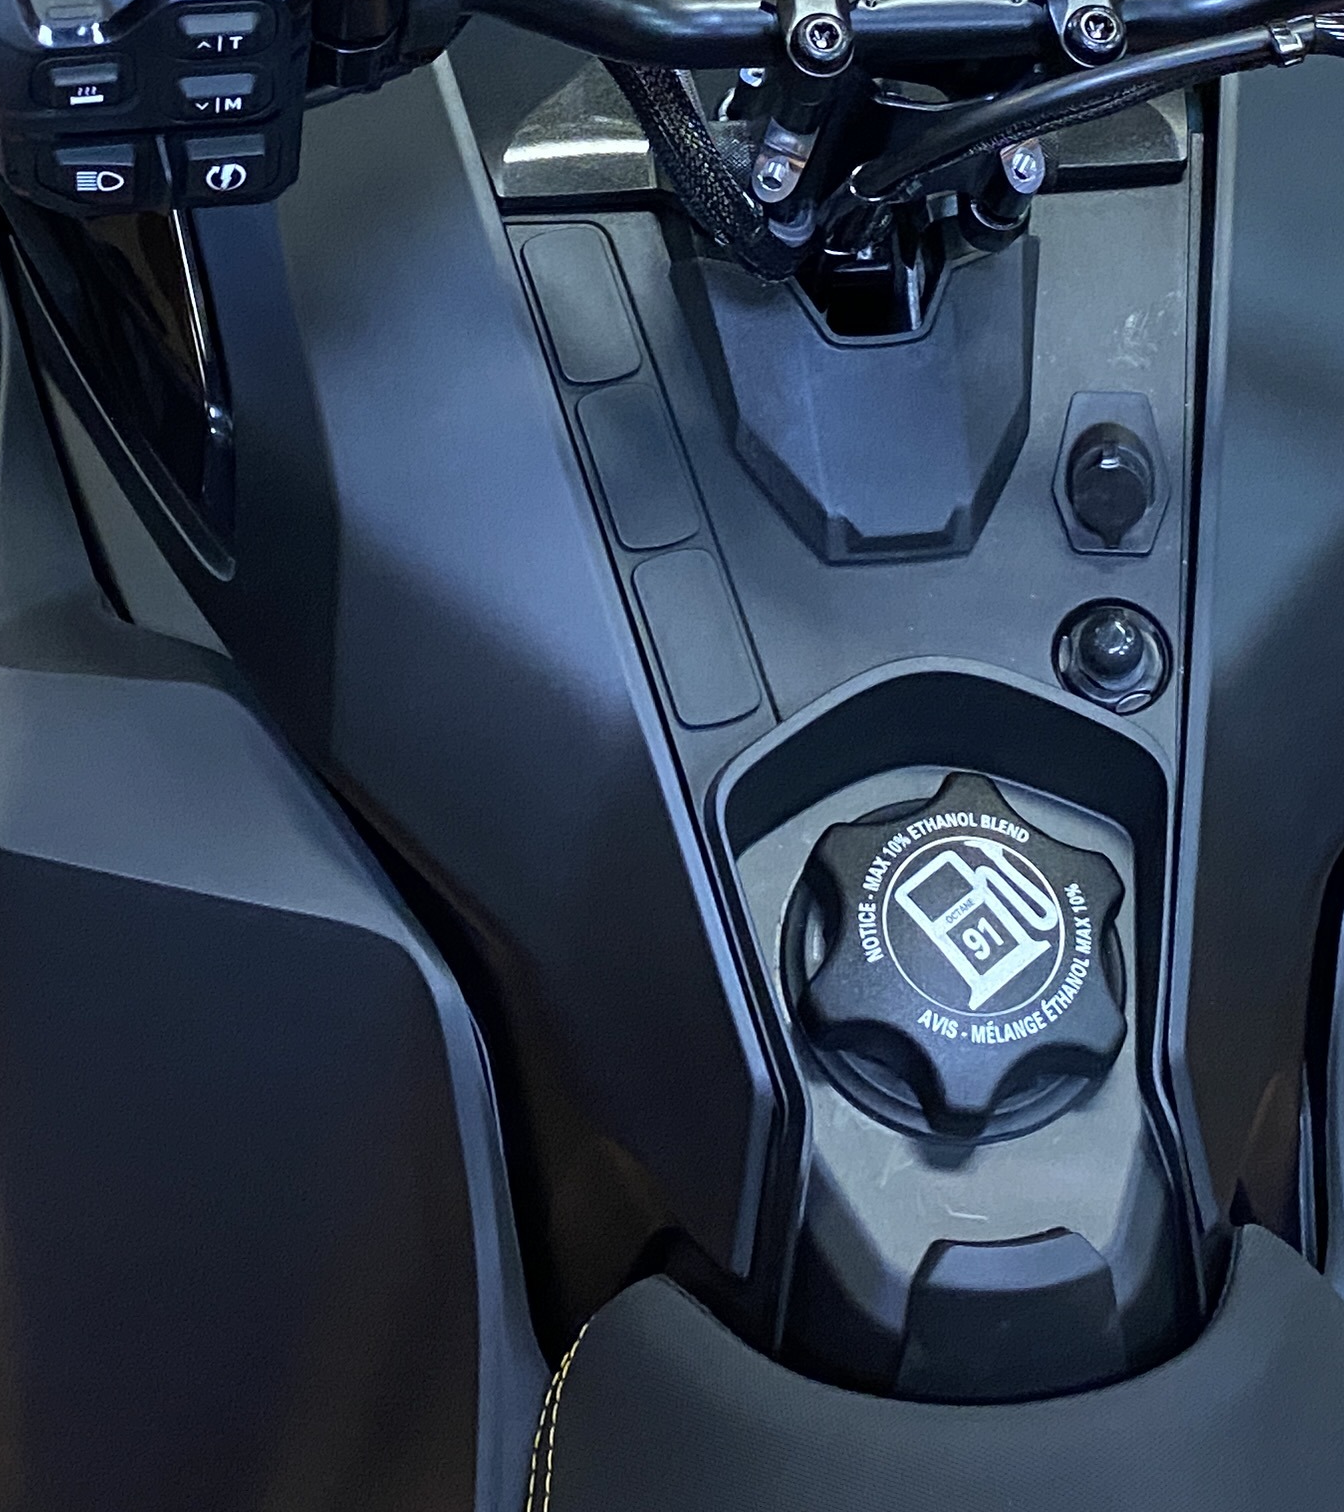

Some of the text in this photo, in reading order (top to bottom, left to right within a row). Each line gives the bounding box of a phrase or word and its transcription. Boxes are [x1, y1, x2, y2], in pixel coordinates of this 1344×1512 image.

[229, 36, 243, 49] T
[224, 97, 242, 111] M
[906, 812, 978, 841] ETHANOL
[981, 814, 1030, 844] BLEND
[882, 832, 911, 859] 10%
[862, 855, 891, 892] MAX
[945, 897, 976, 924] OCTANE
[1064, 882, 1088, 913] 10%
[859, 903, 884, 963] NOTICE
[962, 917, 1004, 961] 91
[1073, 917, 1092, 956] MAX
[1041, 957, 1090, 1023] ÉTHANOL
[917, 1009, 959, 1039] AVIS
[971, 1013, 1047, 1045] MÉLANGE
